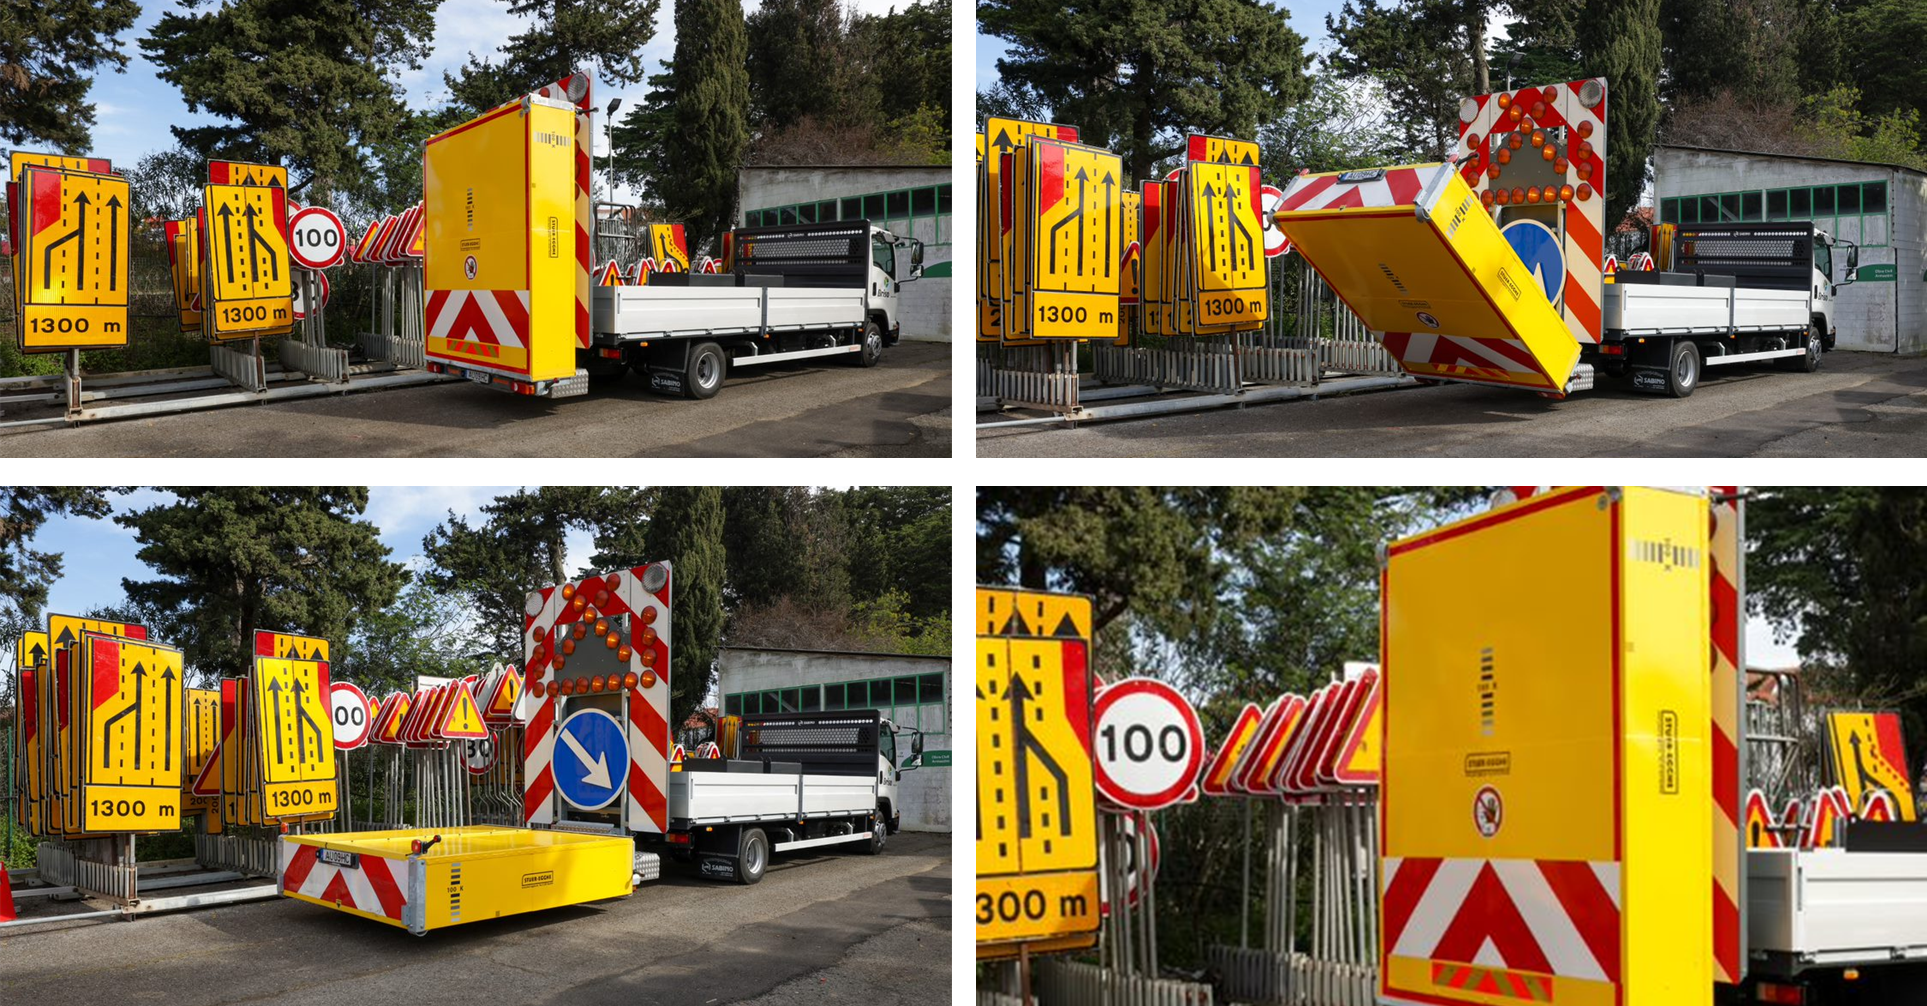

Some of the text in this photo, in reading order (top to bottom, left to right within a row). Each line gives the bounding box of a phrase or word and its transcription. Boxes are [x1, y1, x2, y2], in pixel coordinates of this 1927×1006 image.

[295, 228, 338, 247] 100
[223, 306, 288, 321] 1300 m
[1038, 306, 1113, 324] 1300 m
[1205, 298, 1245, 317] 1300
[1250, 301, 1262, 314] m
[30, 317, 121, 333] 1300 m
[1100, 723, 1187, 763] 100
[272, 789, 332, 807] 1300 m
[91, 800, 175, 817] 1300 m
[1059, 893, 1088, 918] m
